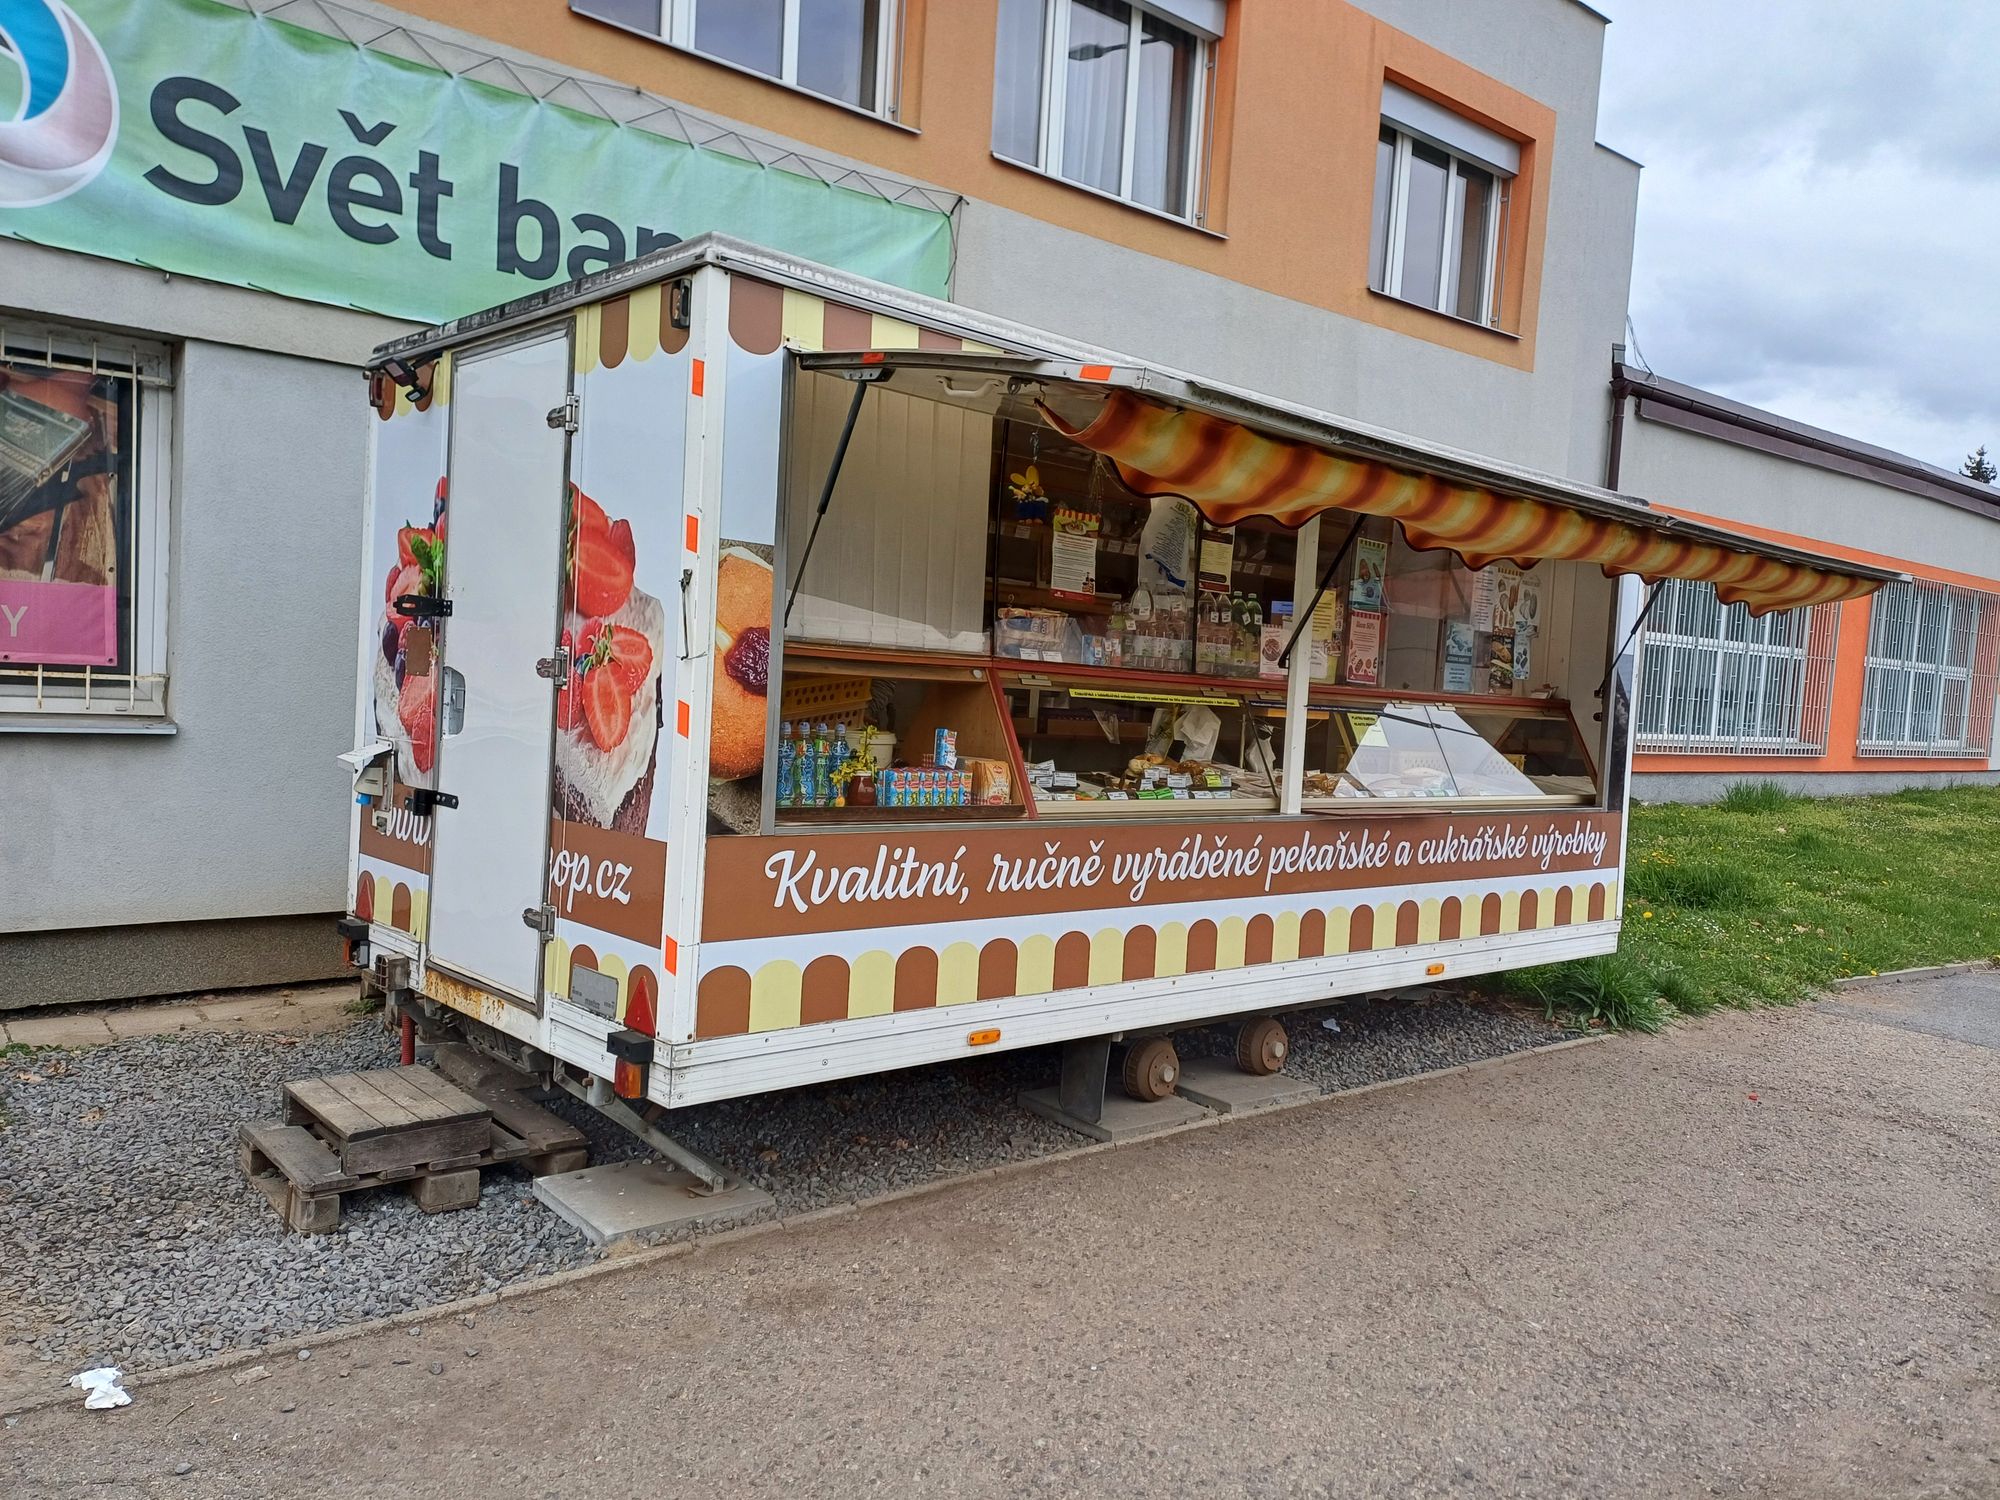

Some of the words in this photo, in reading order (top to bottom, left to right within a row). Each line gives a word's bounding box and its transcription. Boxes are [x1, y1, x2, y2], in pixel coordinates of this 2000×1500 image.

[143, 76, 453, 261] Svět
[764, 844, 970, 914] Kvalitní,
[986, 840, 1105, 893] ručně
[1111, 833, 1263, 902] vyráběné
[1265, 829, 1391, 892] pekařské
[1394, 838, 1414, 867] a
[1417, 824, 1528, 865] cukrářské
[1530, 819, 1608, 871] výrobky
